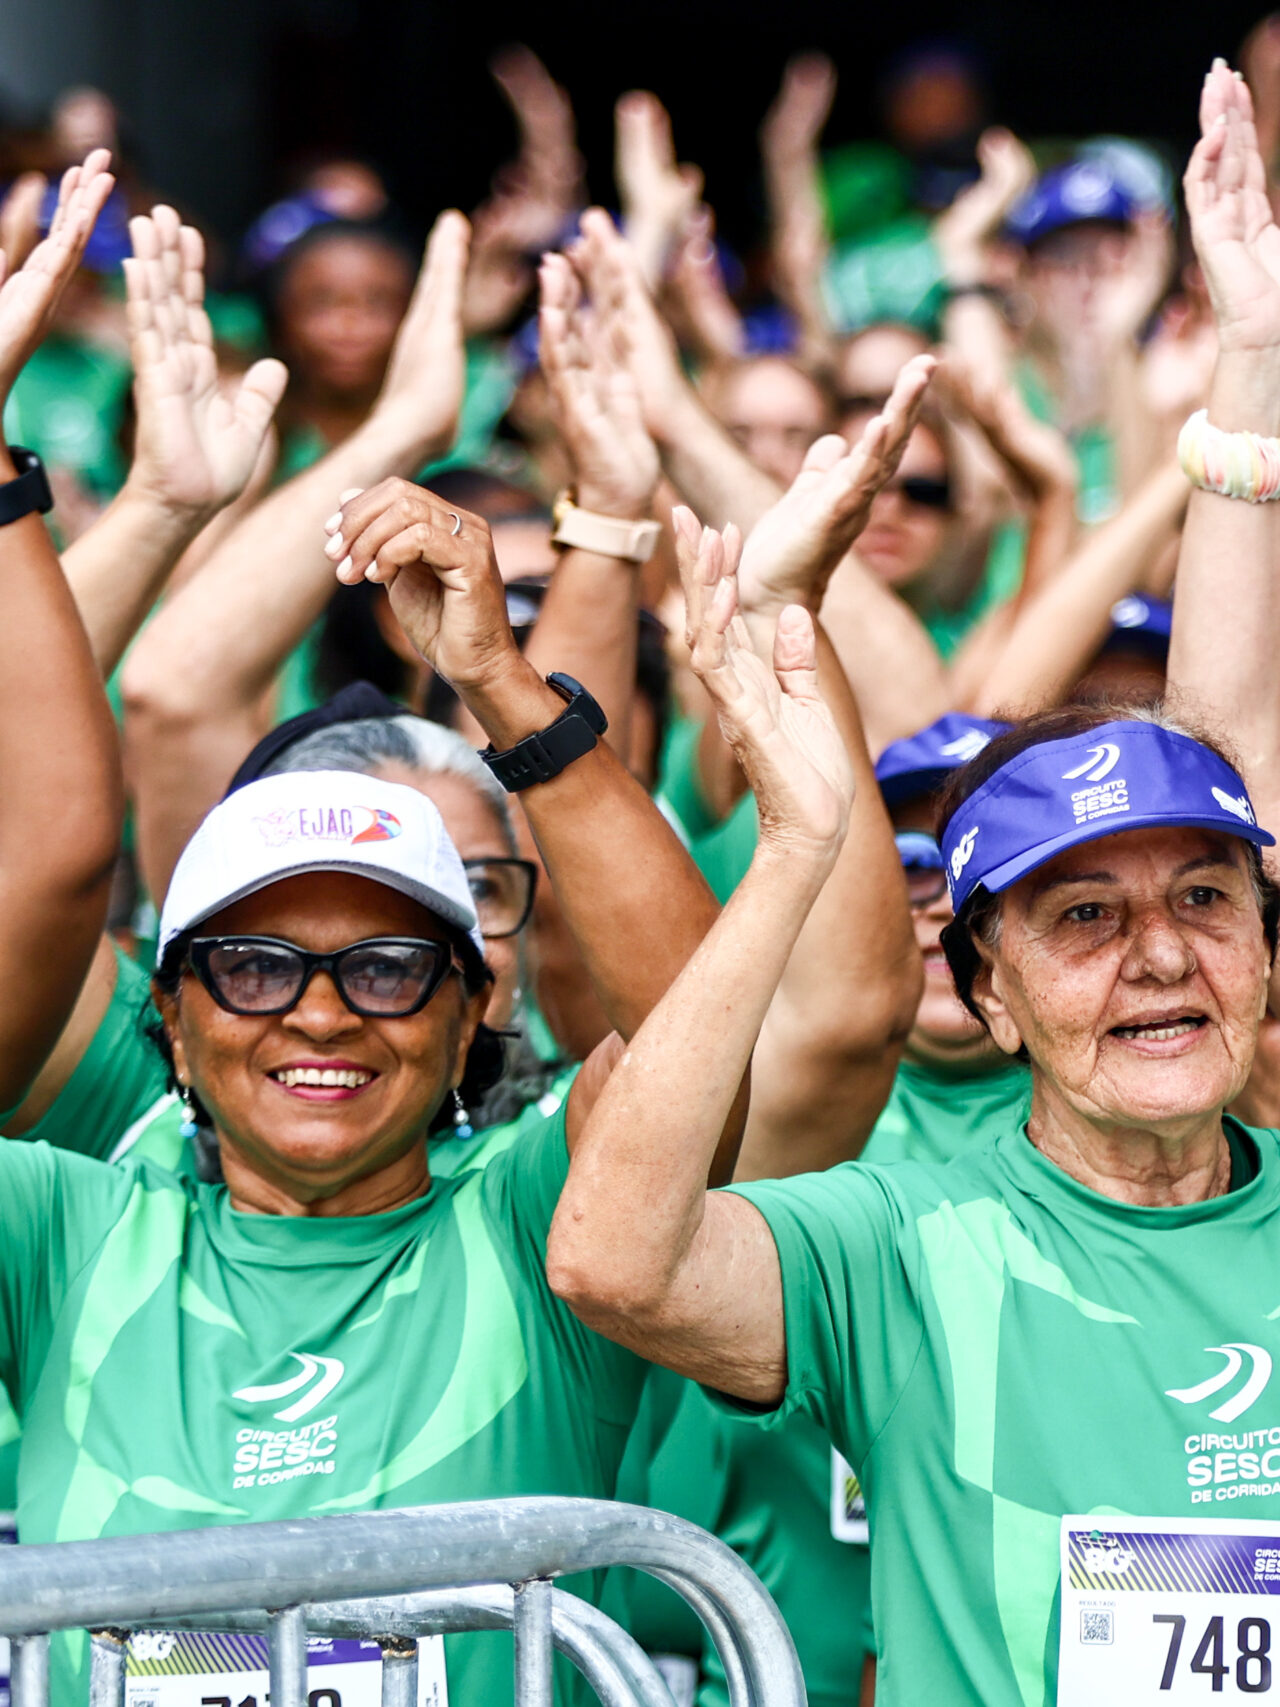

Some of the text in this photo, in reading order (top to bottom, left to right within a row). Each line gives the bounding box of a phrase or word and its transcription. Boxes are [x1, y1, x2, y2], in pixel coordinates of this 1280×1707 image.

[1073, 789, 1129, 816] SESC
[236, 1415, 338, 1443] CIRCUITO
[233, 1430, 338, 1473] SESC
[233, 1460, 336, 1489] DE CORRIDAS
[1191, 1489, 1213, 1504] DE
[1254, 1573, 1263, 1581] DE
